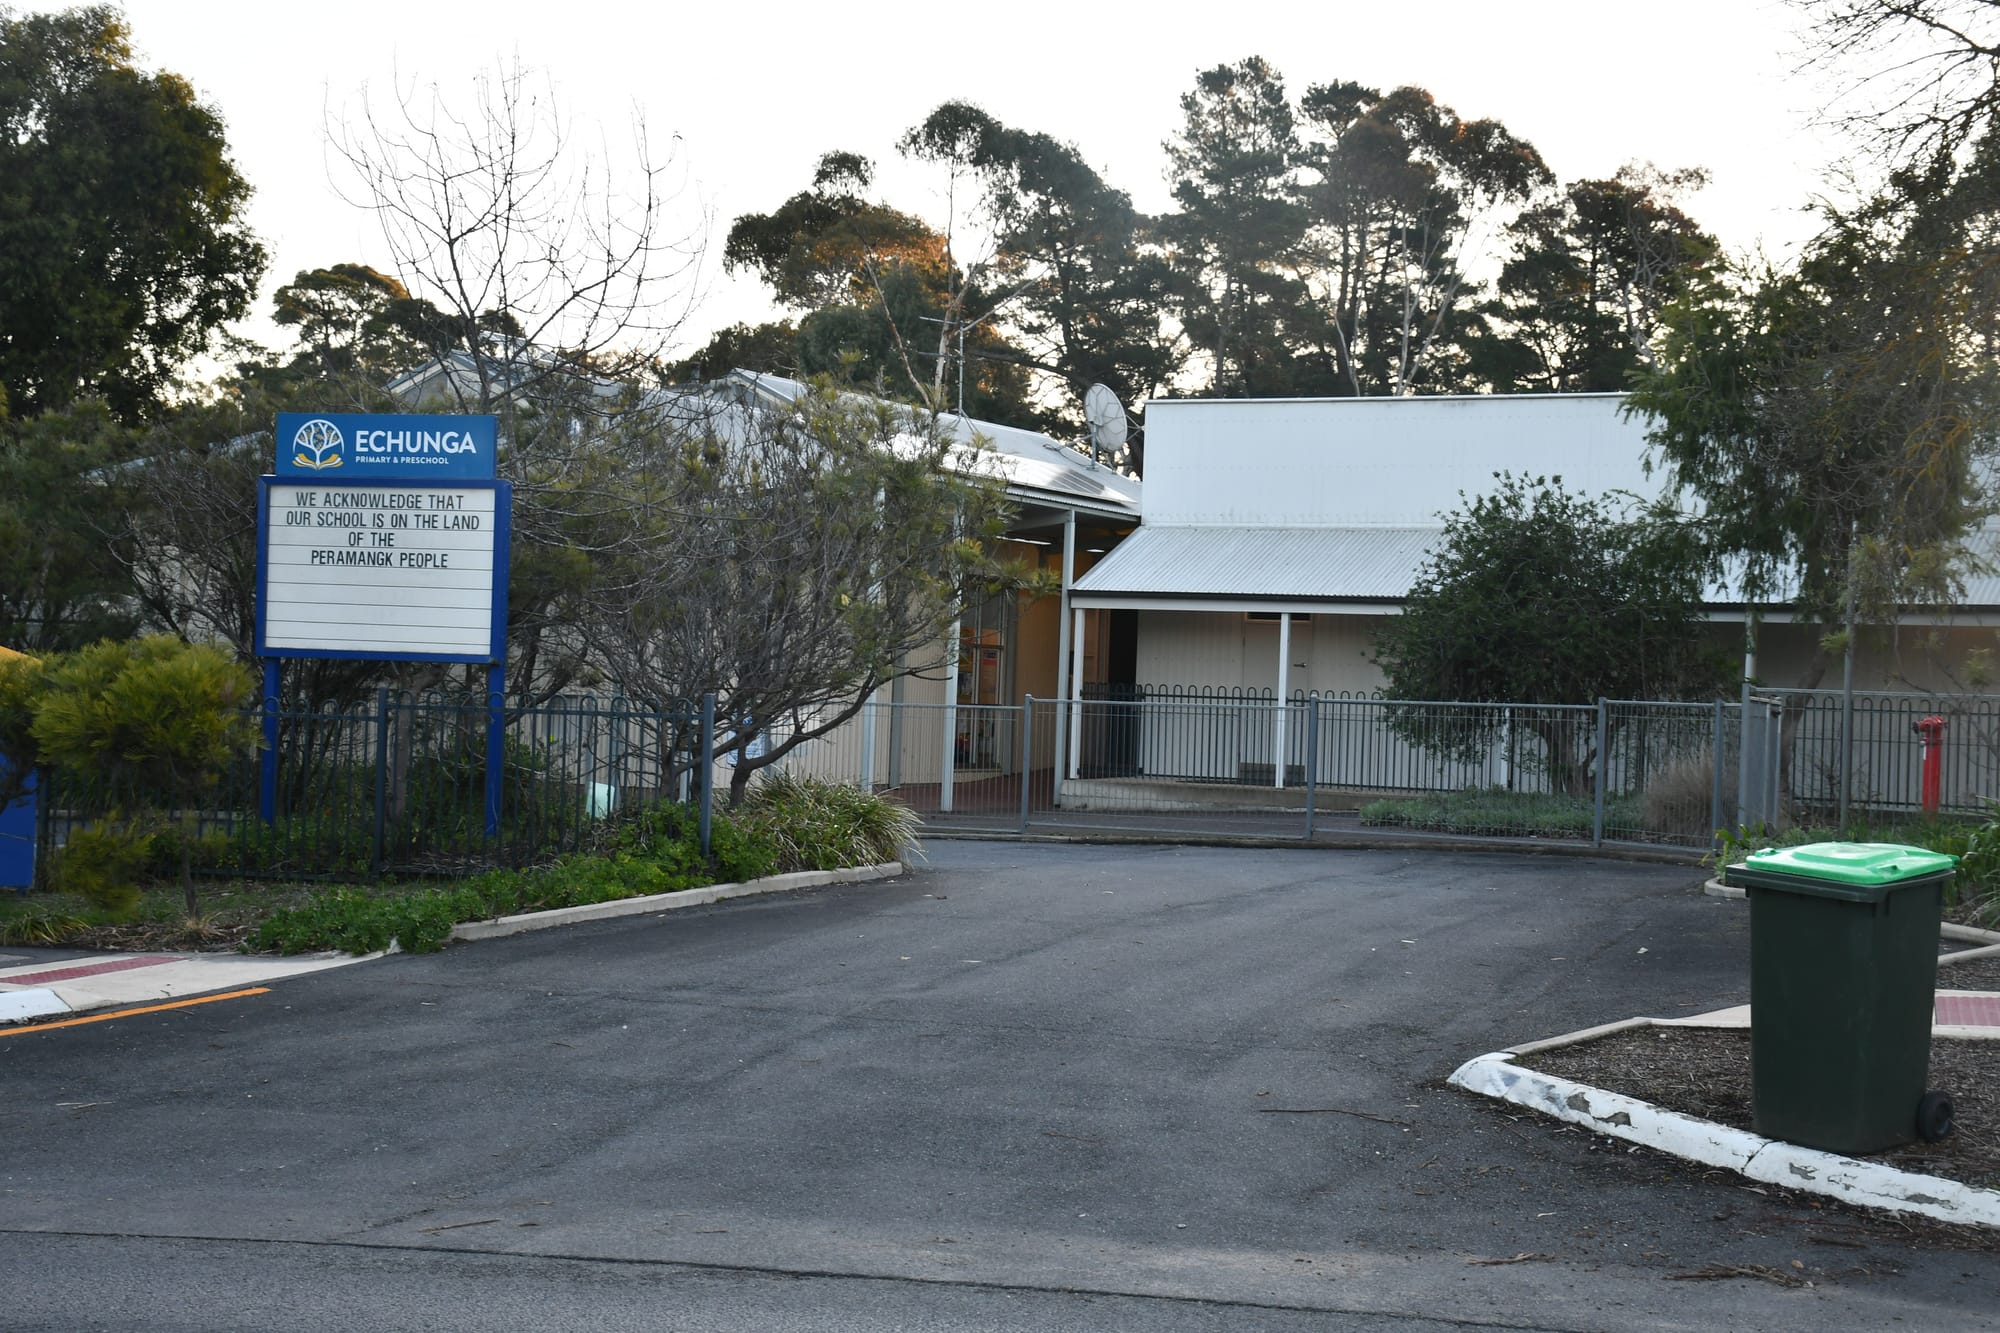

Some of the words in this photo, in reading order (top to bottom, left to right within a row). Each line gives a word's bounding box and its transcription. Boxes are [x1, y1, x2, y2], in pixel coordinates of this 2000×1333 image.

[355, 430, 476, 454] ECHUNGA
[401, 457, 449, 465] PRESCHOOL
[296, 492, 316, 506] WE
[324, 493, 422, 509] ACKNOWLEDGE
[428, 495, 464, 510] THAT
[287, 511, 311, 526] OUR
[317, 513, 367, 527] SCHOOL
[373, 514, 384, 528] IS
[391, 514, 408, 528] ON
[414, 515, 438, 529] THE
[444, 516, 480, 530] LAND
[348, 532, 364, 547] OF
[371, 532, 395, 547] THE
[311, 551, 393, 566] PERAMANGK
[400, 552, 448, 568] PEOPLE
